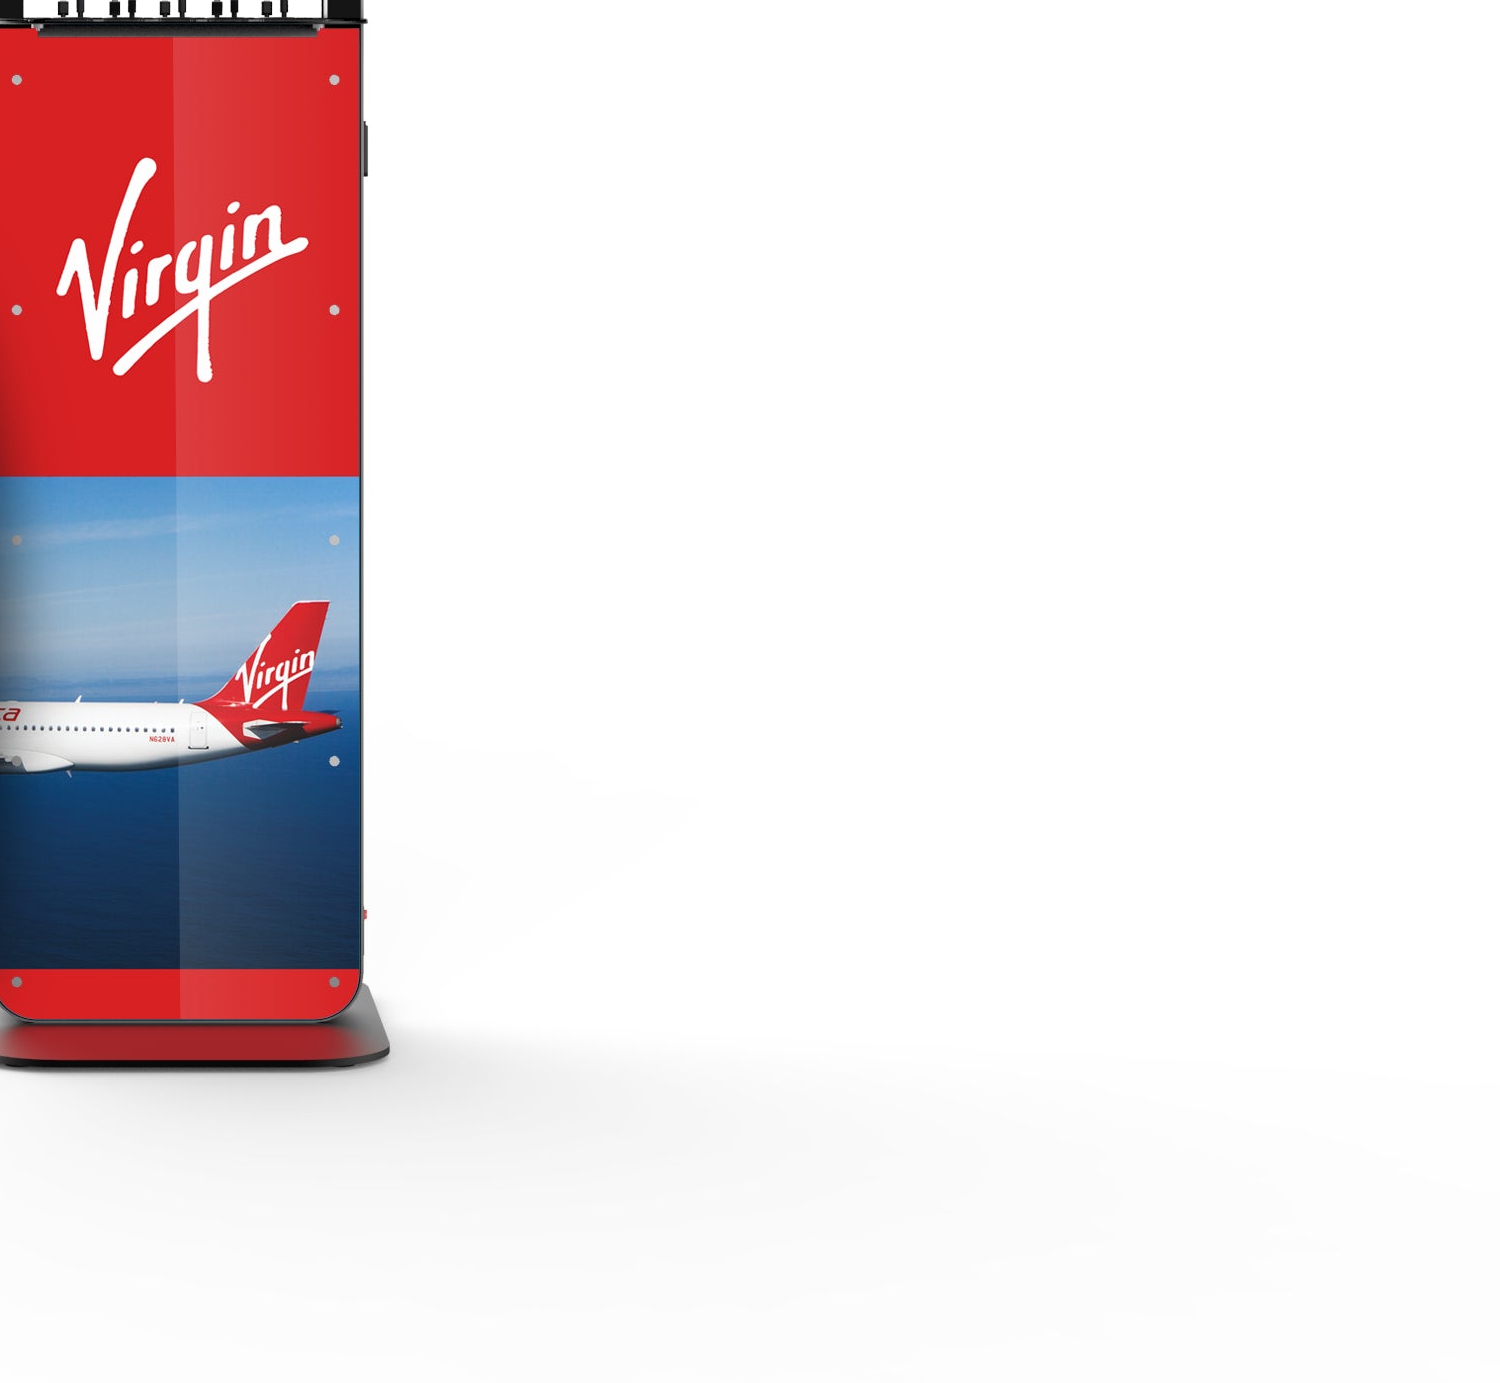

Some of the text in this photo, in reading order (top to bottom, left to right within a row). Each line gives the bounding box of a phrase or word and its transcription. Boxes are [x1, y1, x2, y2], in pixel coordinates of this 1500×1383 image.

[56, 157, 309, 383] Virgin
[235, 633, 315, 711] Virgin
[149, 735, 176, 744] N628VA
